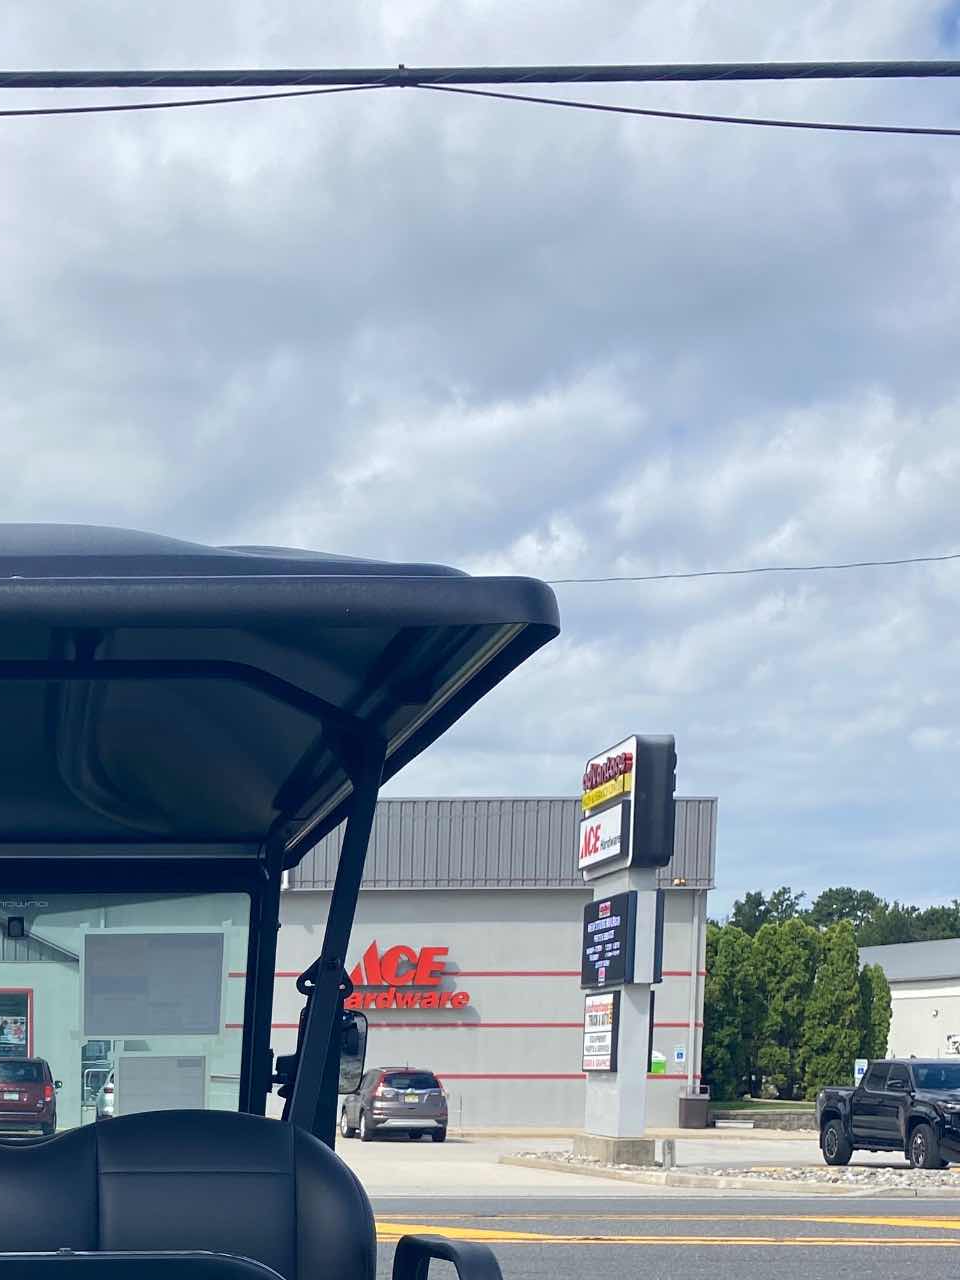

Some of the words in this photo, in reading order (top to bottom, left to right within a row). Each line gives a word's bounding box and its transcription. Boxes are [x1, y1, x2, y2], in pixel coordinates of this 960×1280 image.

[581, 823, 602, 859] ACE
[349, 940, 449, 987] ACE
[344, 987, 471, 1009] ardware
